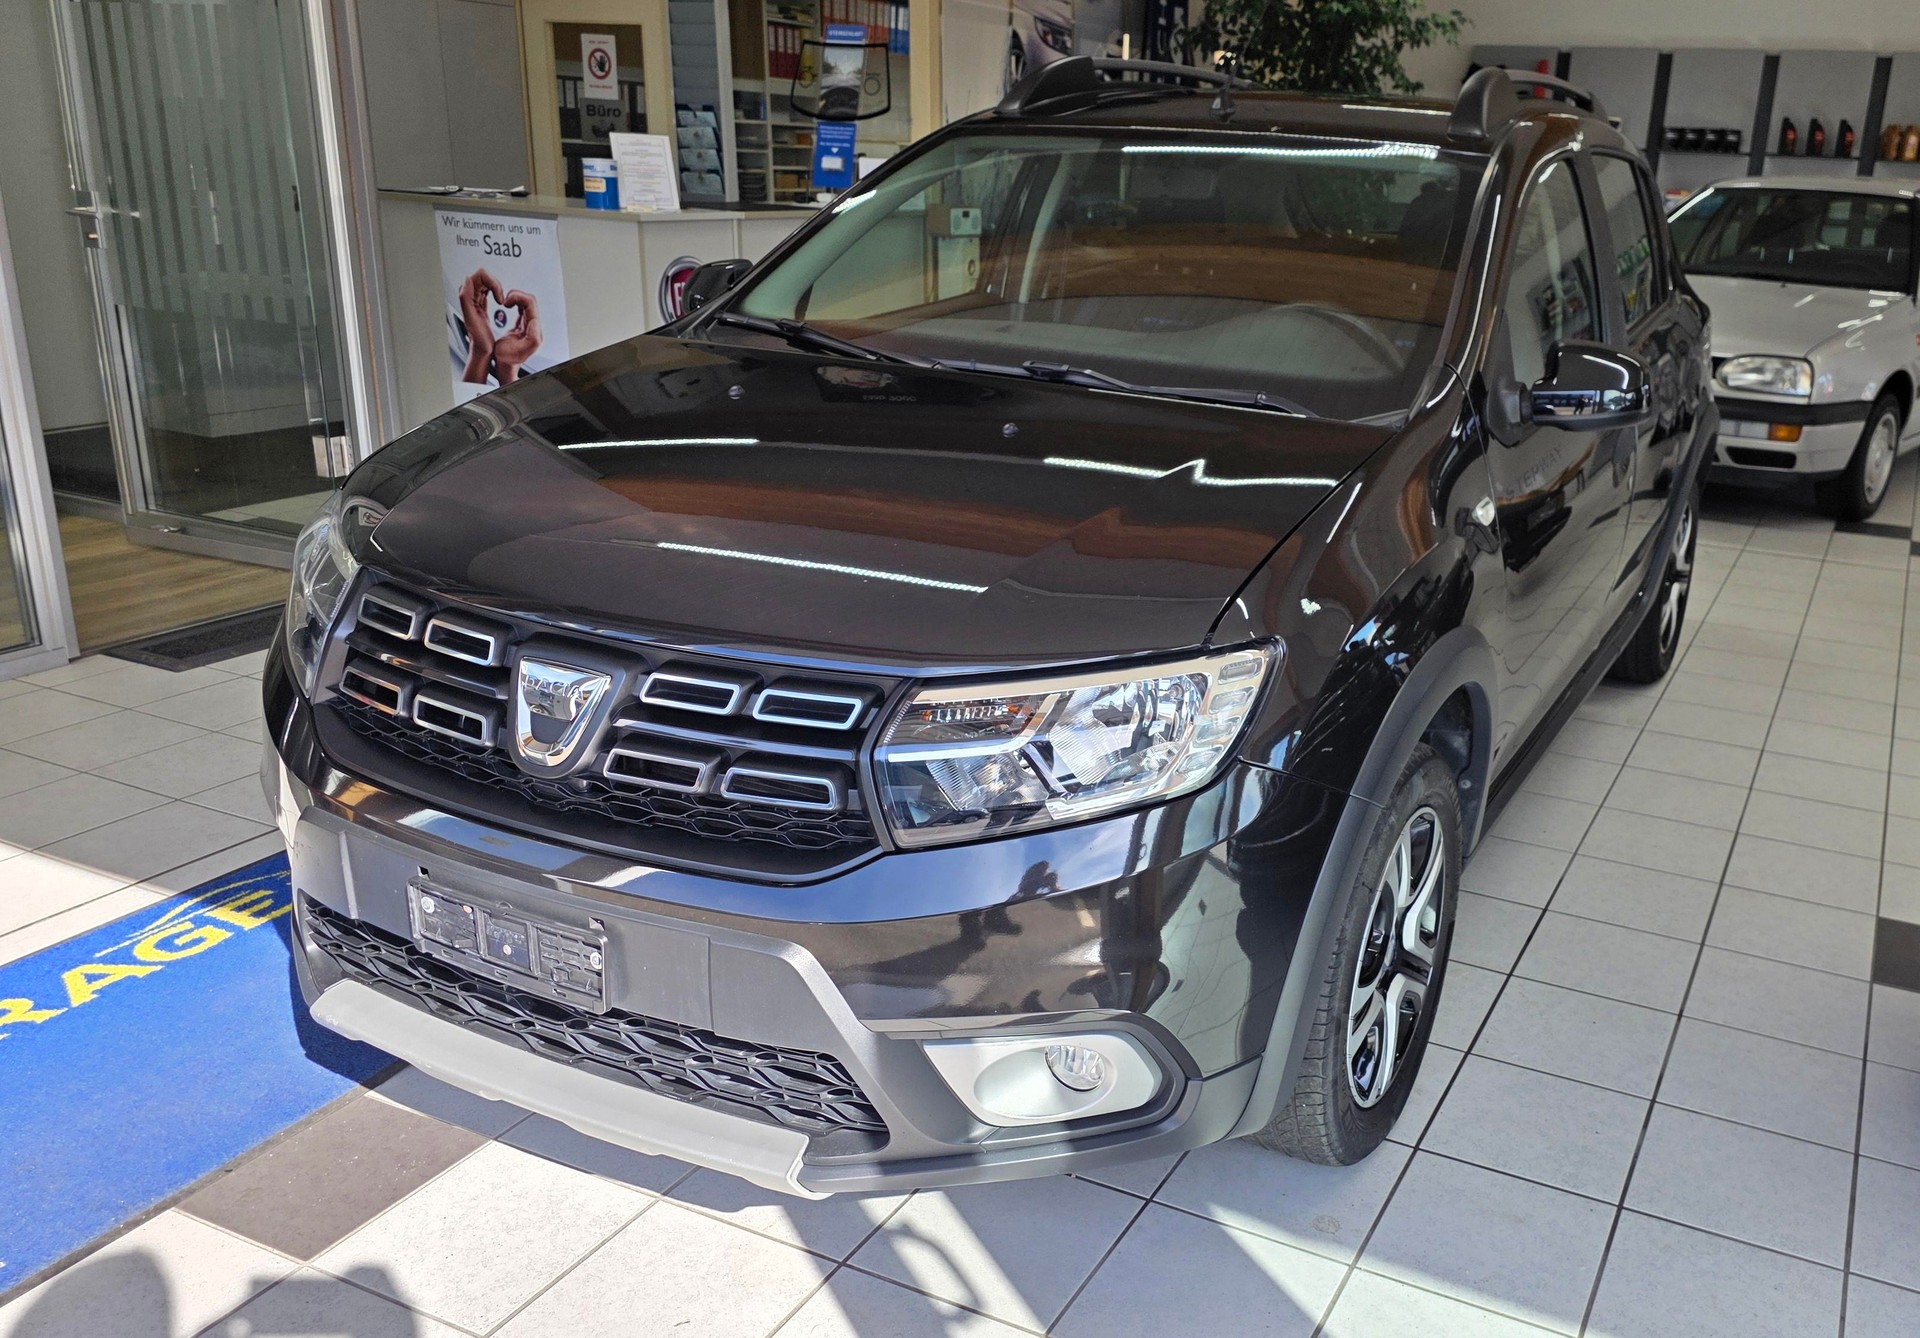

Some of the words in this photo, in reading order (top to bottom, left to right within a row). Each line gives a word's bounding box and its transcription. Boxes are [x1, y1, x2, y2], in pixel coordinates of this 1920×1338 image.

[586, 105, 621, 117] Büro
[441, 215, 460, 227] Wir
[462, 217, 505, 232] kümmern
[508, 225, 524, 233] uns
[526, 227, 541, 235] um
[456, 235, 480, 247] Ihren
[483, 234, 522, 258] Saab
[1507, 444, 1562, 499] STEPWAY
[525, 674, 579, 699] DACIA
